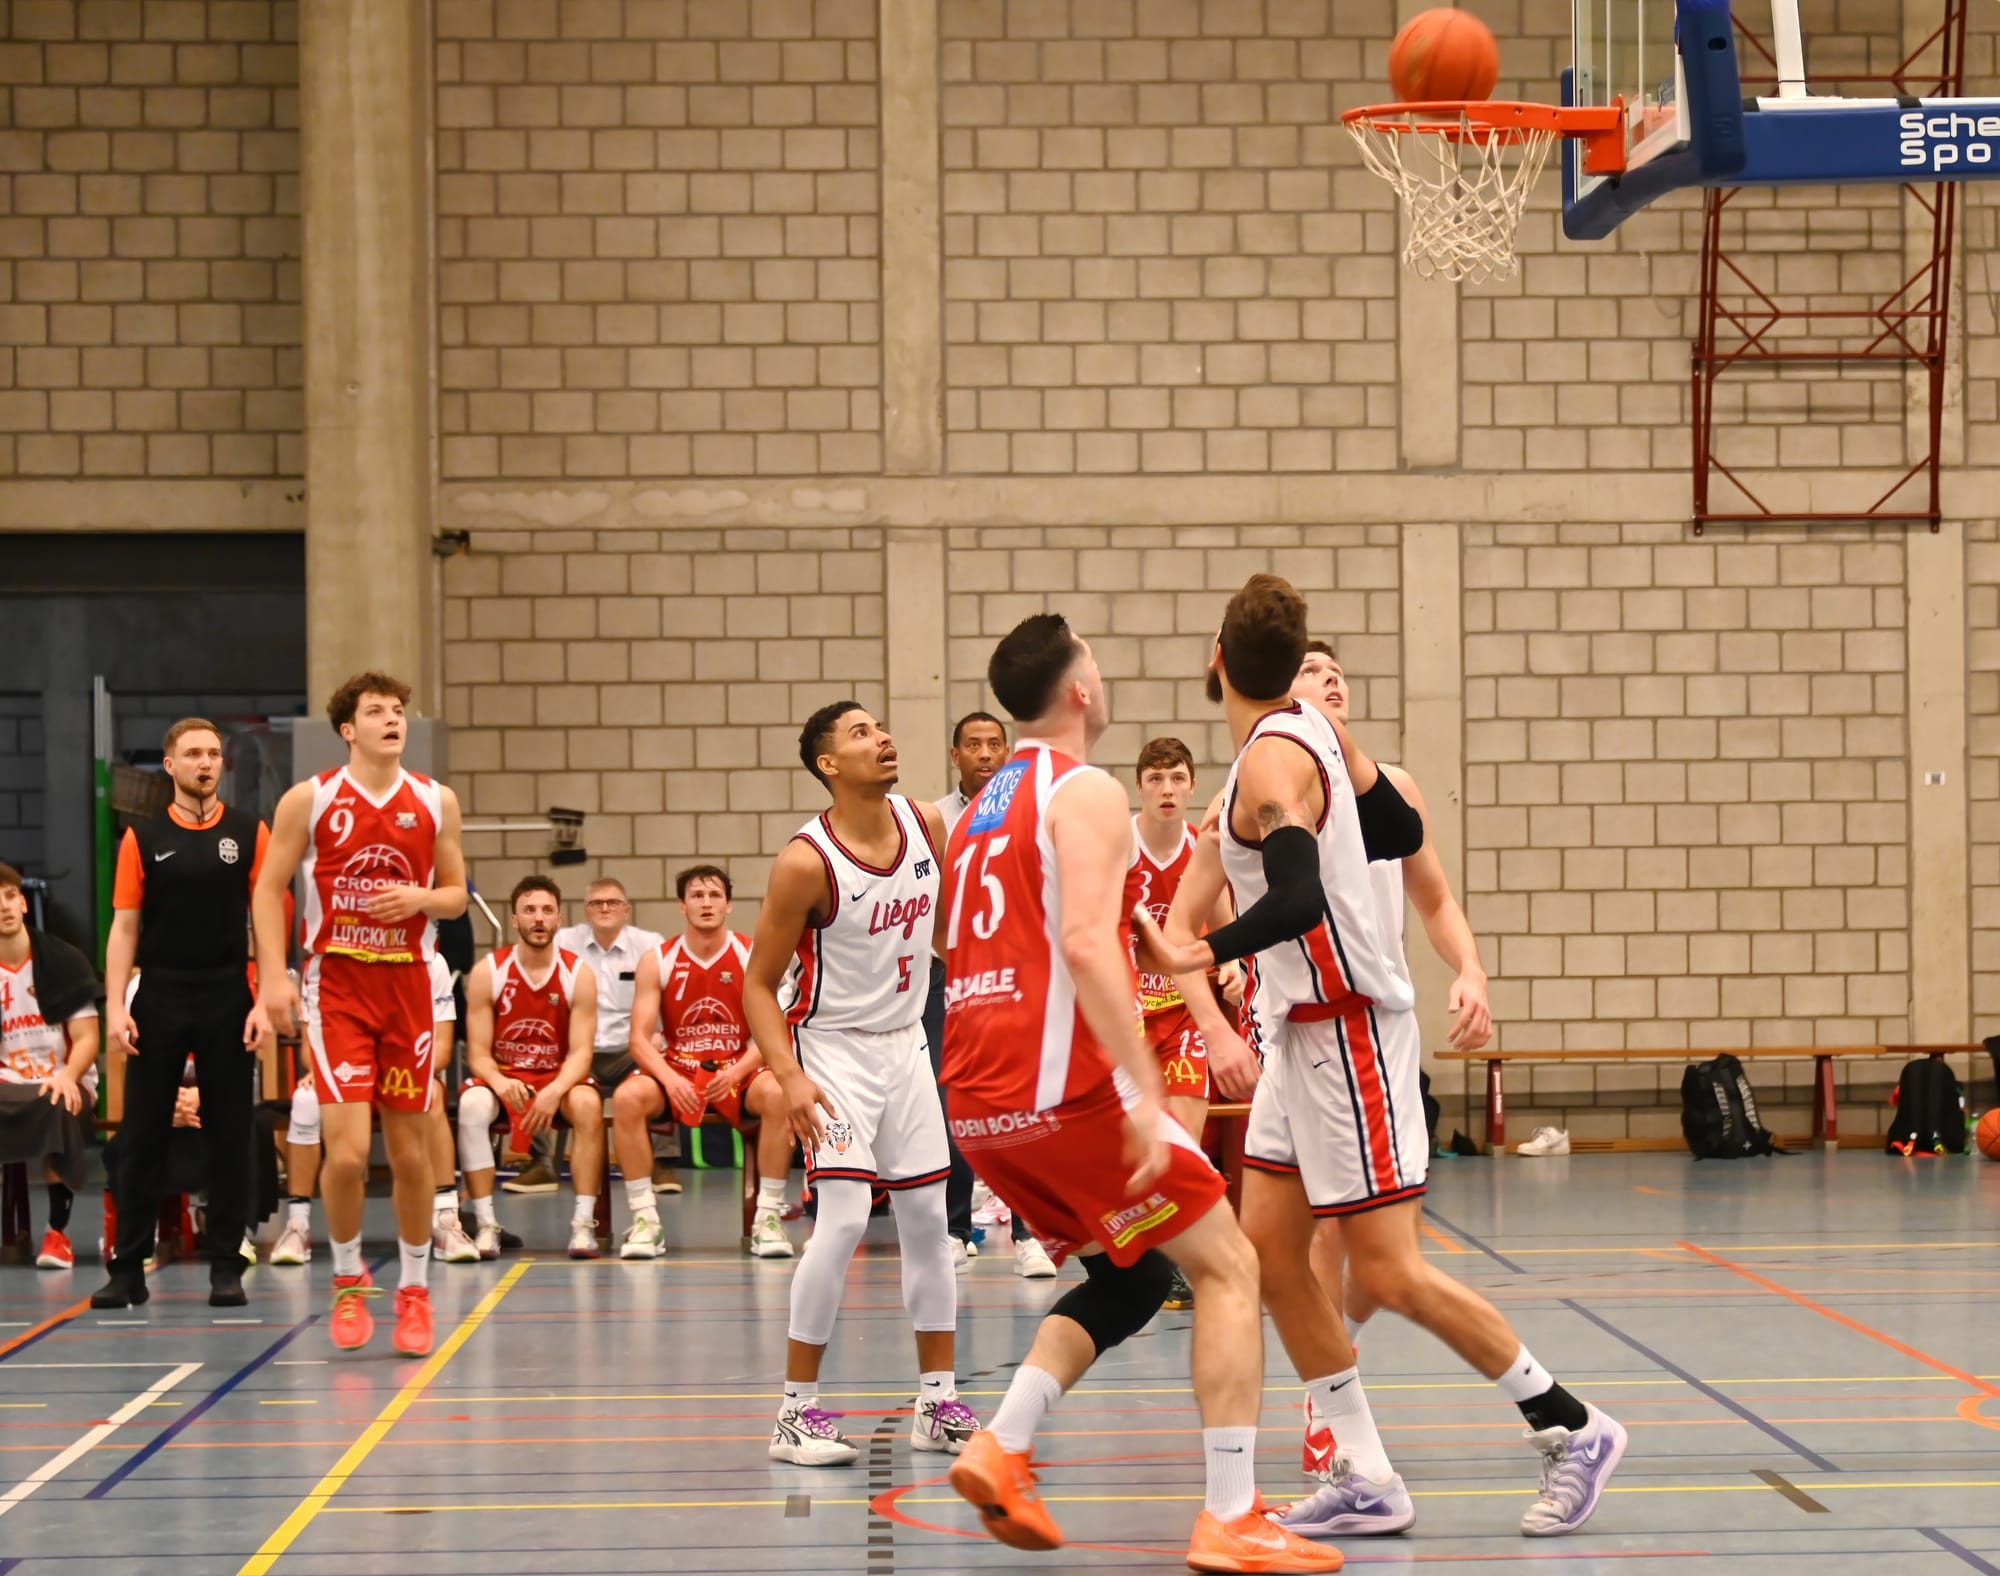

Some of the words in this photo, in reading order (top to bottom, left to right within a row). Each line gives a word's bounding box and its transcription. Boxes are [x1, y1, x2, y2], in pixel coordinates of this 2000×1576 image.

[1900, 112, 2000, 138] Sche
[1900, 140, 1991, 172] Spo
[328, 808, 355, 848] 9
[946, 834, 1011, 950] 15
[868, 893, 931, 941] Liège
[675, 971, 690, 1001] 7
[896, 954, 914, 994] 5
[414, 1030, 432, 1070] 9
[494, 1040, 559, 1056] CROONE
[674, 1038, 741, 1053] NISSAN
